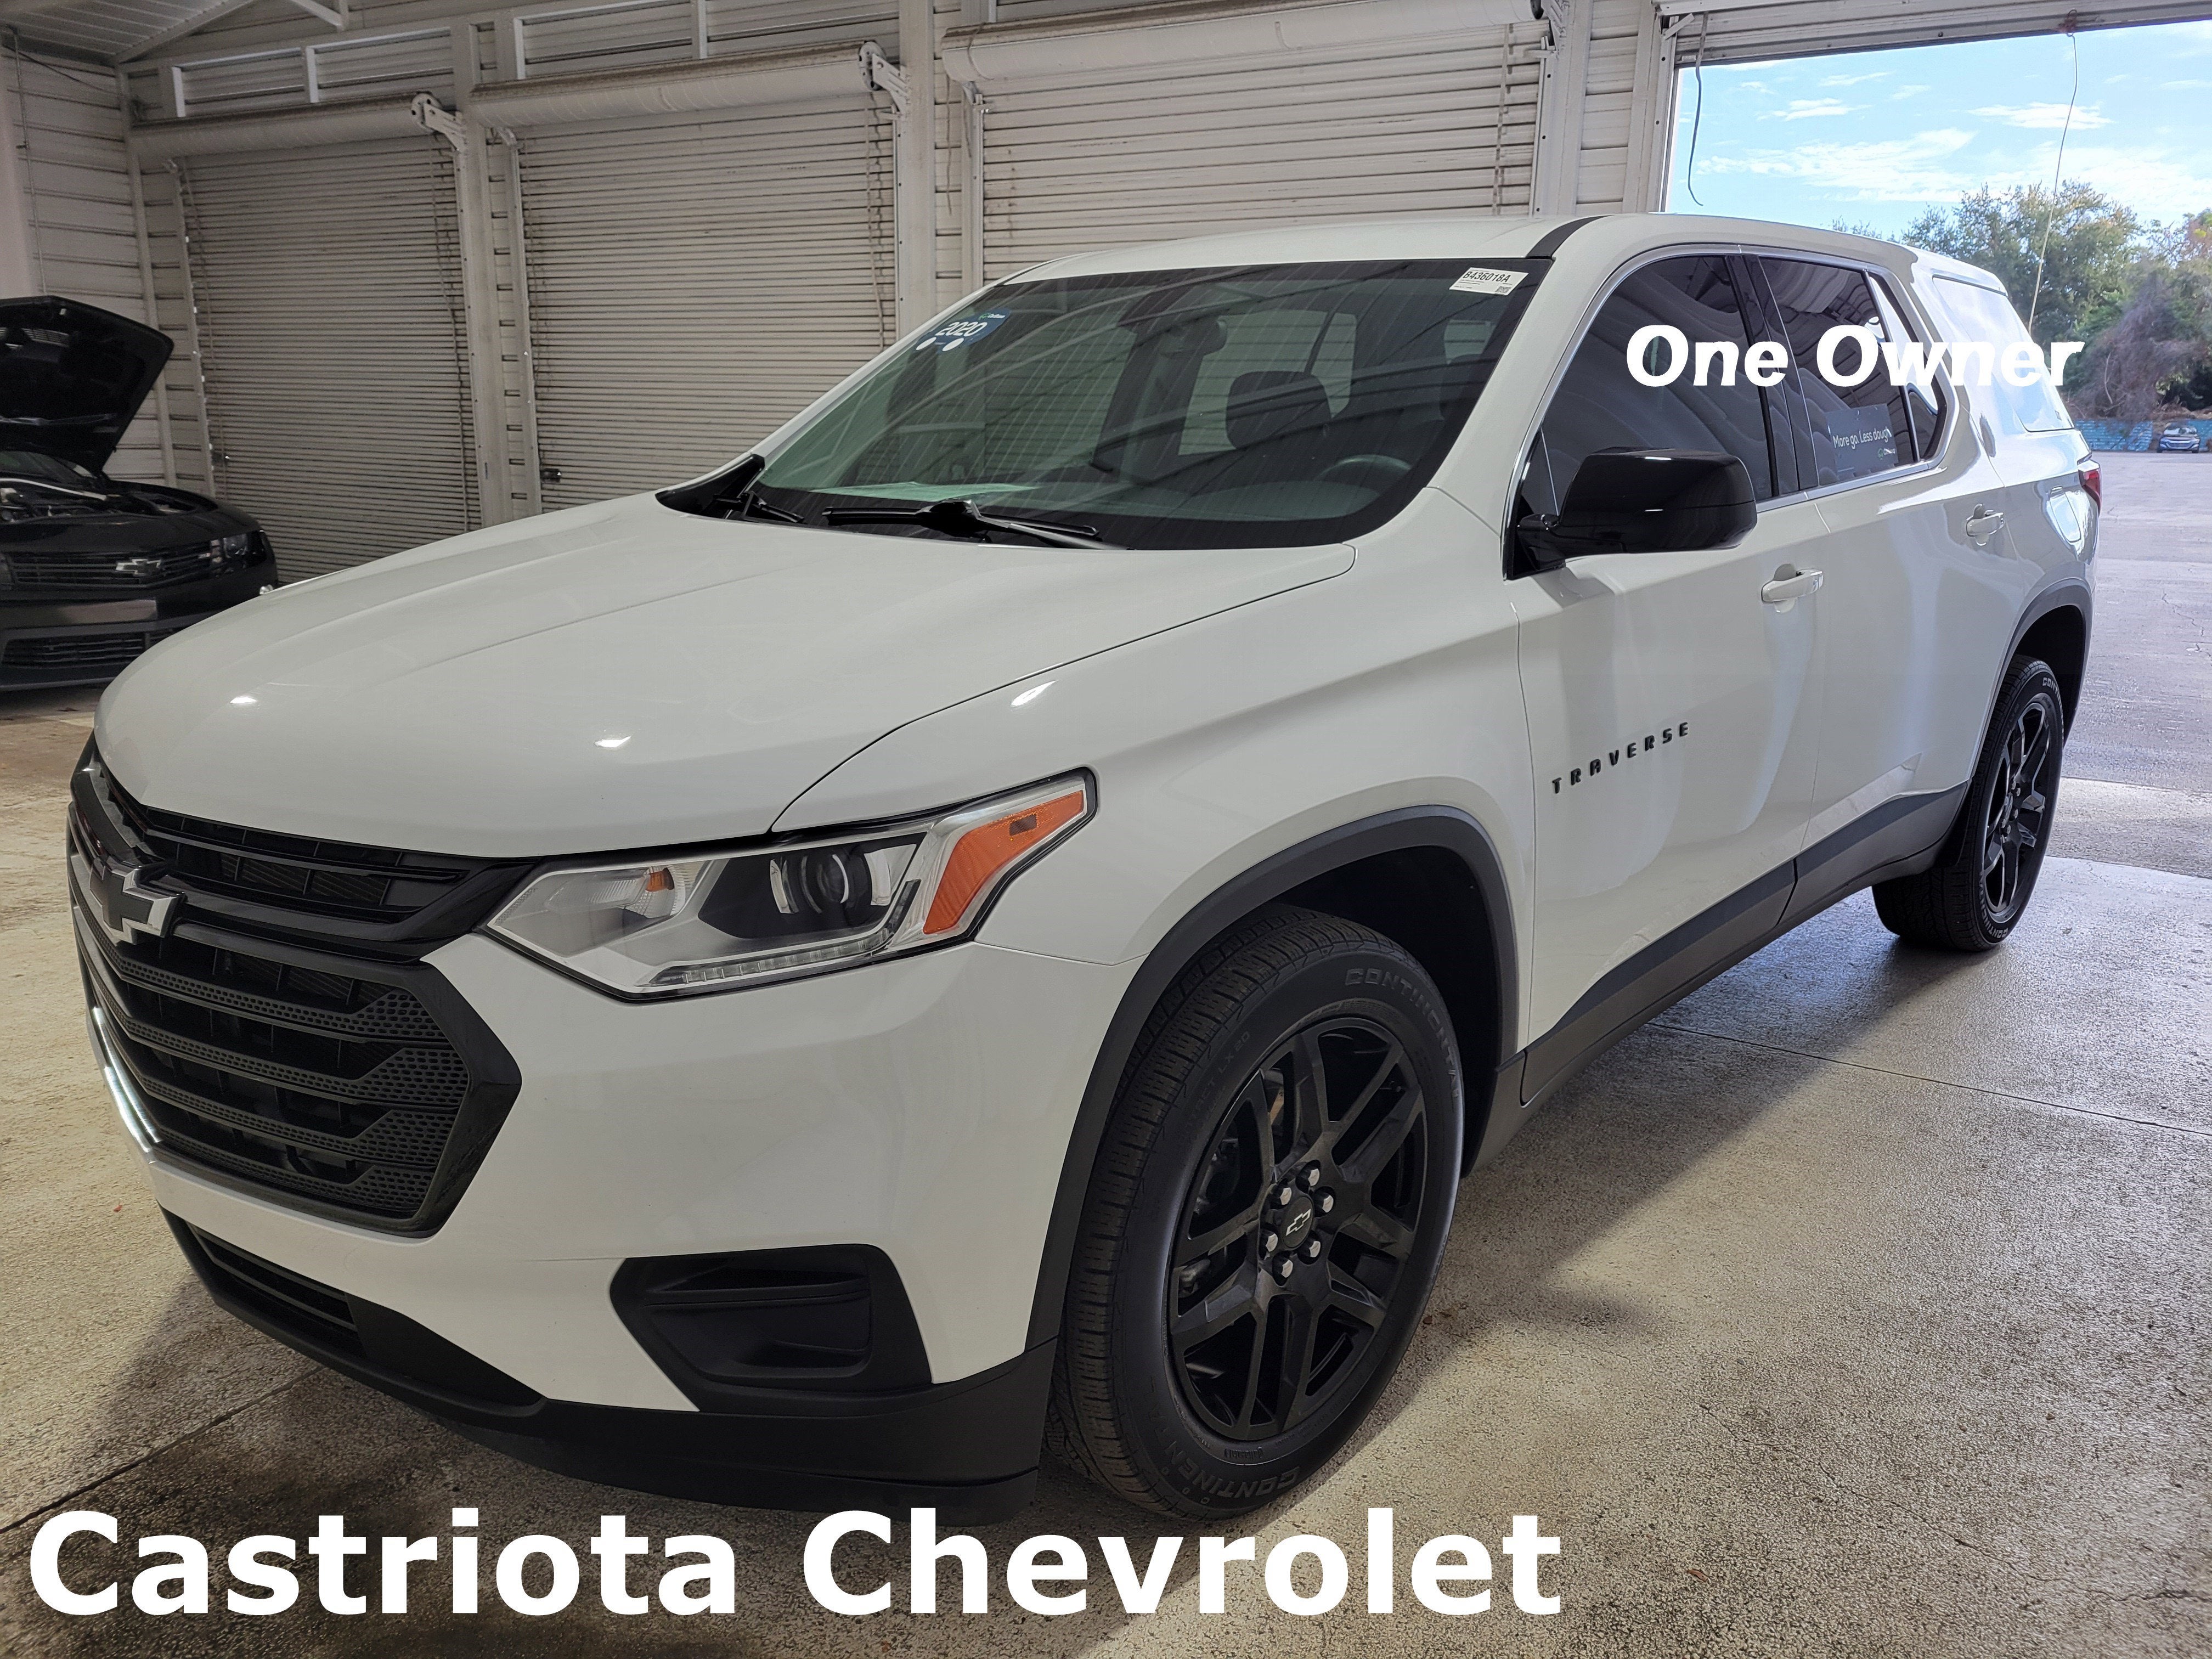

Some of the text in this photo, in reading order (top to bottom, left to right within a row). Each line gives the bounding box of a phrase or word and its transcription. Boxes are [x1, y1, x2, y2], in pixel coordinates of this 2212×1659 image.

[1463, 271, 1511, 283] B436018A
[934, 321, 988, 337] 2020
[1832, 435, 1850, 448] More
[1850, 435, 1860, 450] go.
[1859, 430, 1873, 443] Less
[1552, 721, 1689, 793] TRAVERSE
